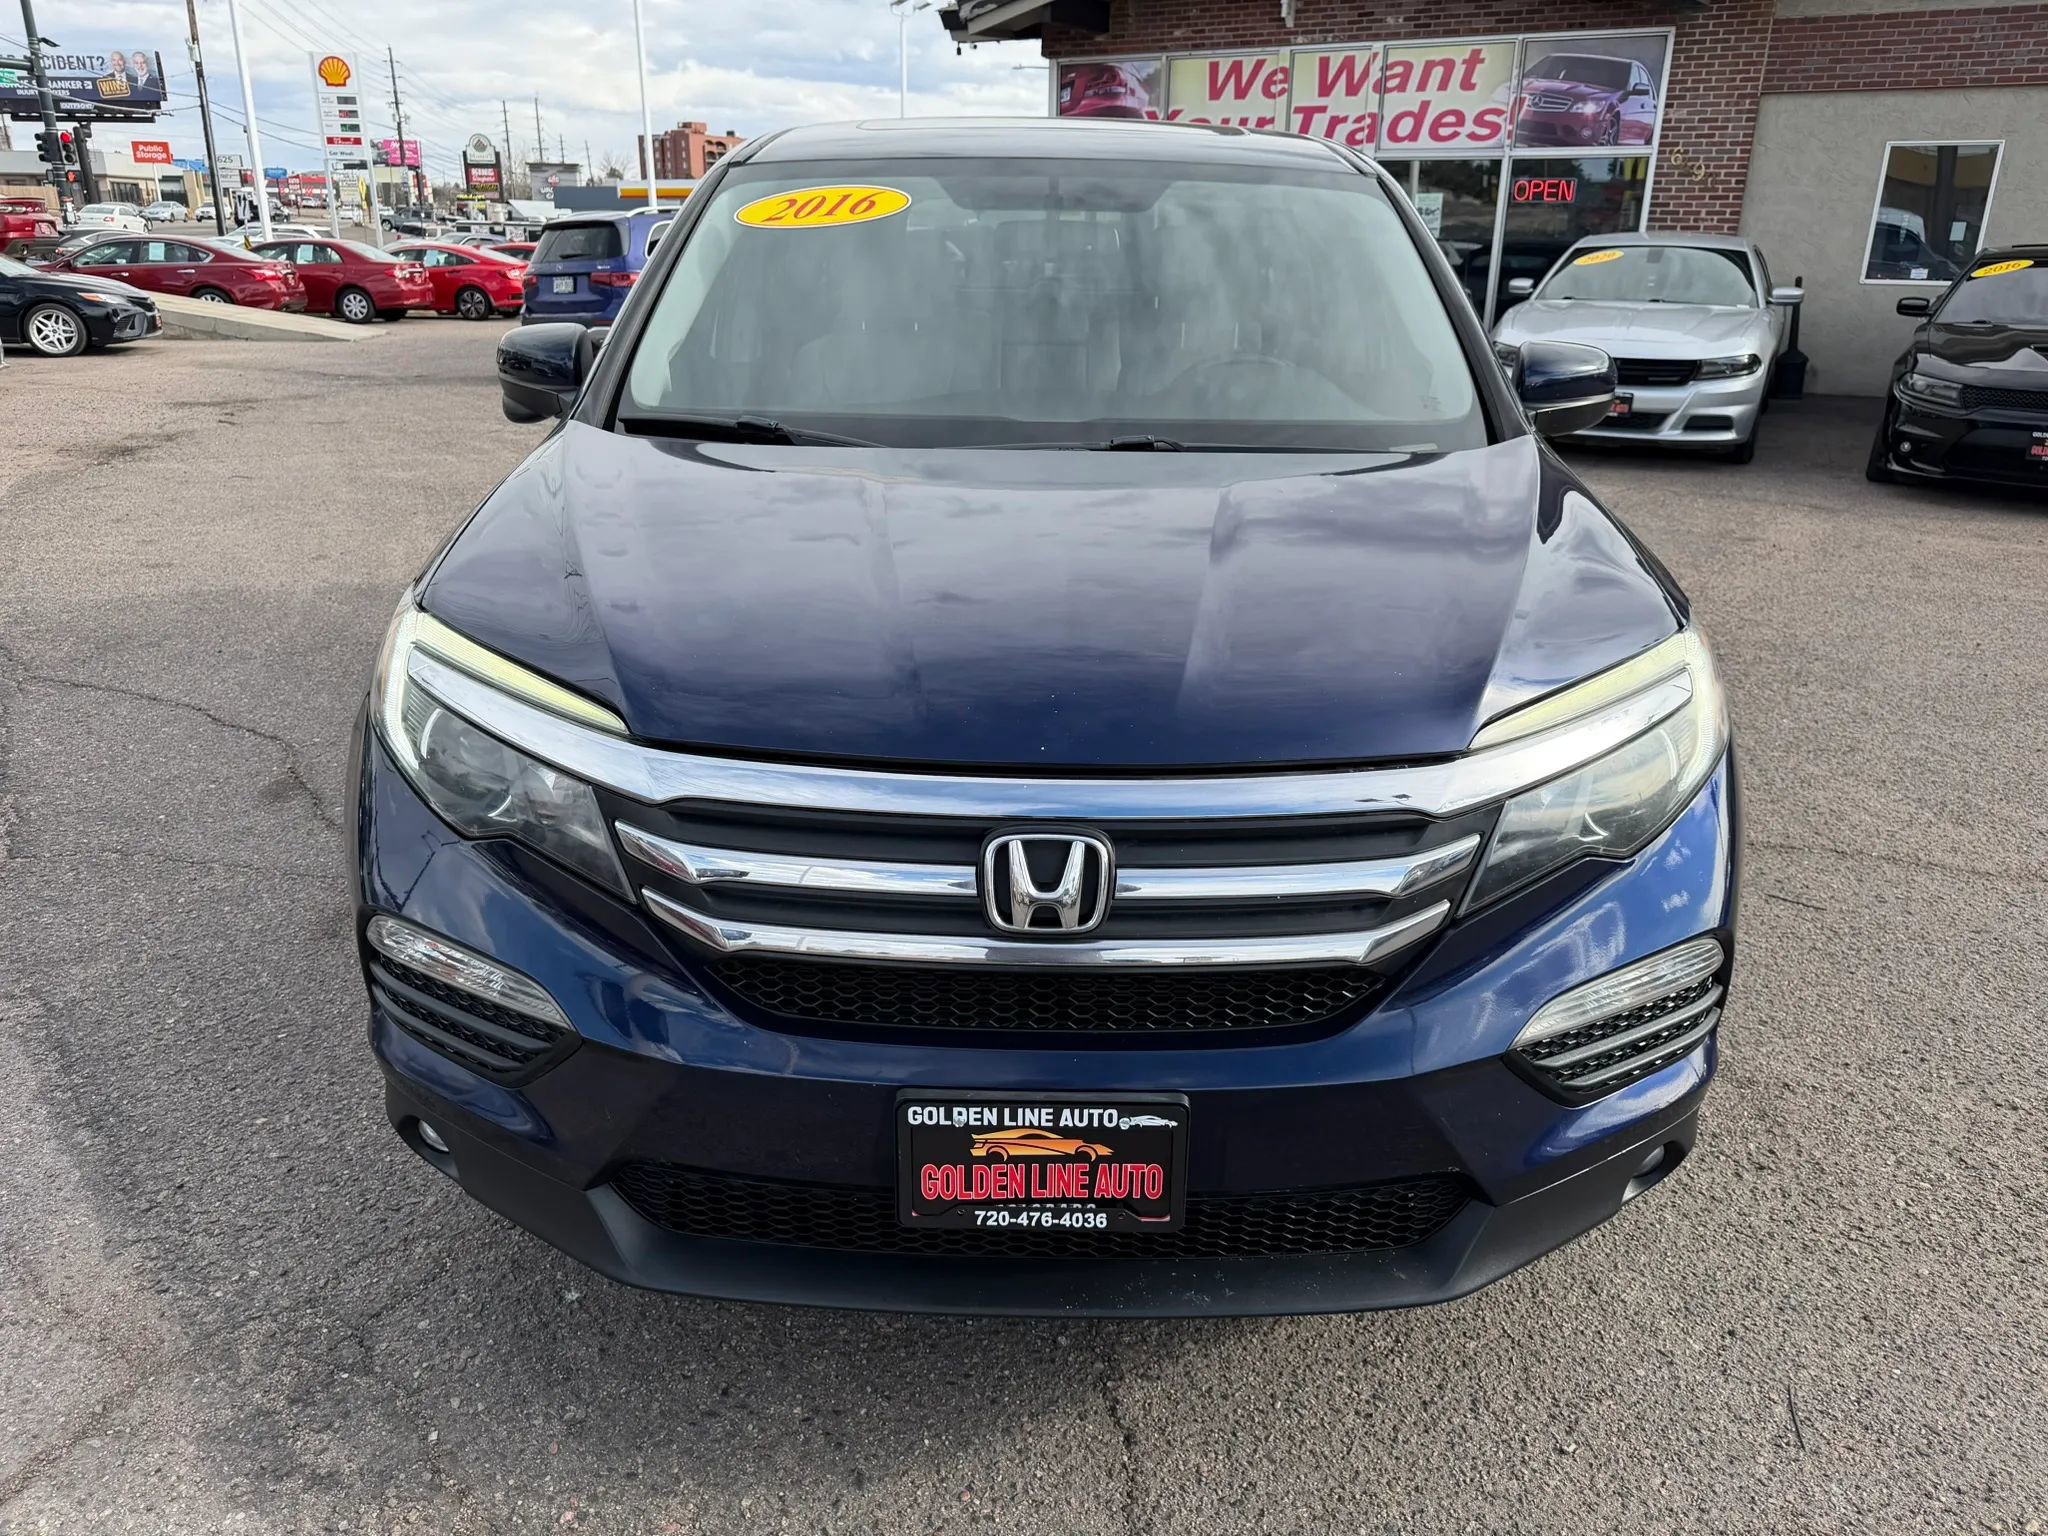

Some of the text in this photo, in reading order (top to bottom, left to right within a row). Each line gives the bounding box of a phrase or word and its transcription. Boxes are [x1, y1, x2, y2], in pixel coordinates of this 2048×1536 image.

[1206, 47, 1486, 101] We Want
[1292, 97, 1527, 147] Trades!
[135, 151, 167, 160] Storage
[138, 144, 163, 153] Public
[1514, 180, 1573, 202] OPEN
[760, 190, 885, 223] 2016
[1983, 262, 2021, 275] 2016
[907, 1106, 1118, 1127] GOLDEN LINE AUTO
[920, 1163, 1164, 1200] GOLDEN LINE AUTO
[974, 1210, 1108, 1228] 720-476-4036
